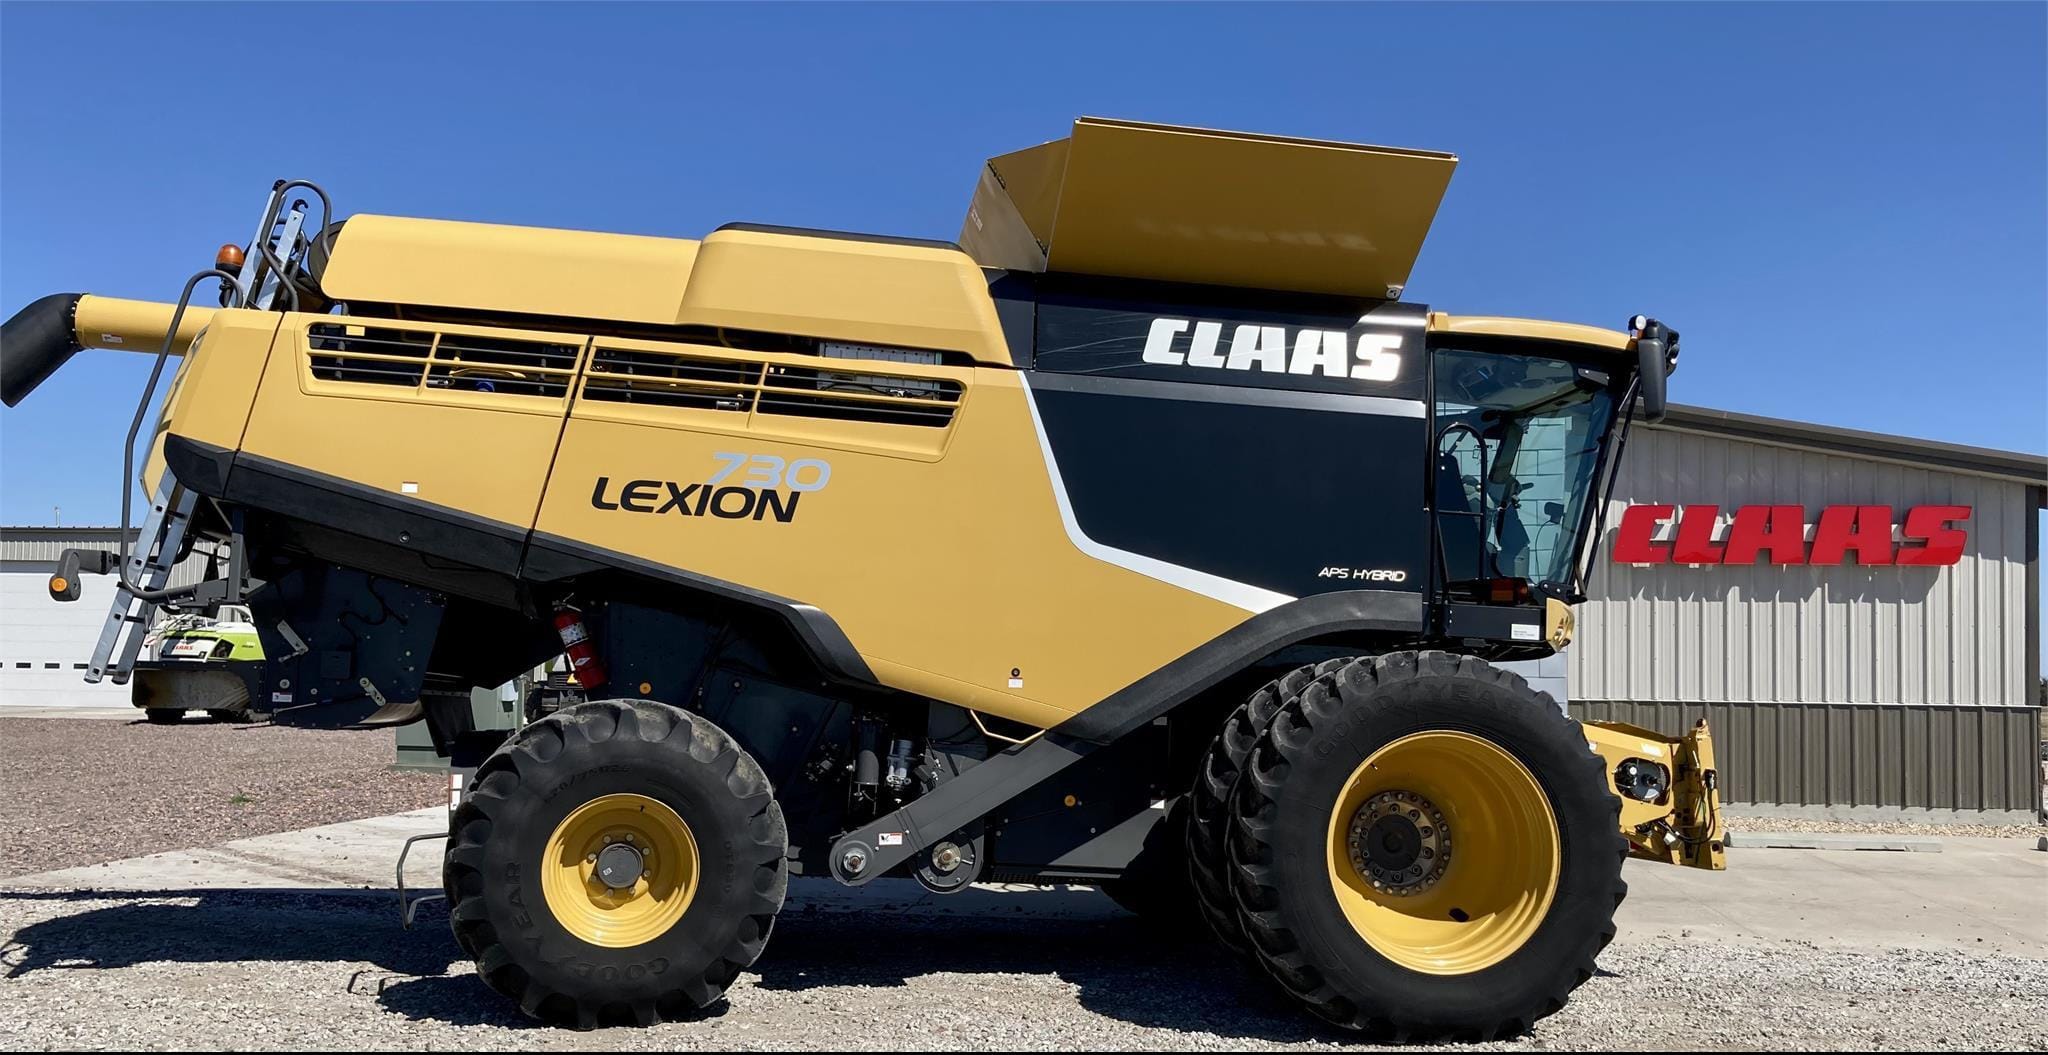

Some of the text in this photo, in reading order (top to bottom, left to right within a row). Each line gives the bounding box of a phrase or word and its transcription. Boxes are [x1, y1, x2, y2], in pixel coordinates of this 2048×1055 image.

[1142, 318, 1403, 382] CLAAS
[707, 452, 831, 492] 730
[591, 477, 800, 522] LEXION
[1613, 505, 1972, 566] CLAAS
[1317, 567, 1406, 582] APS HYBRID
